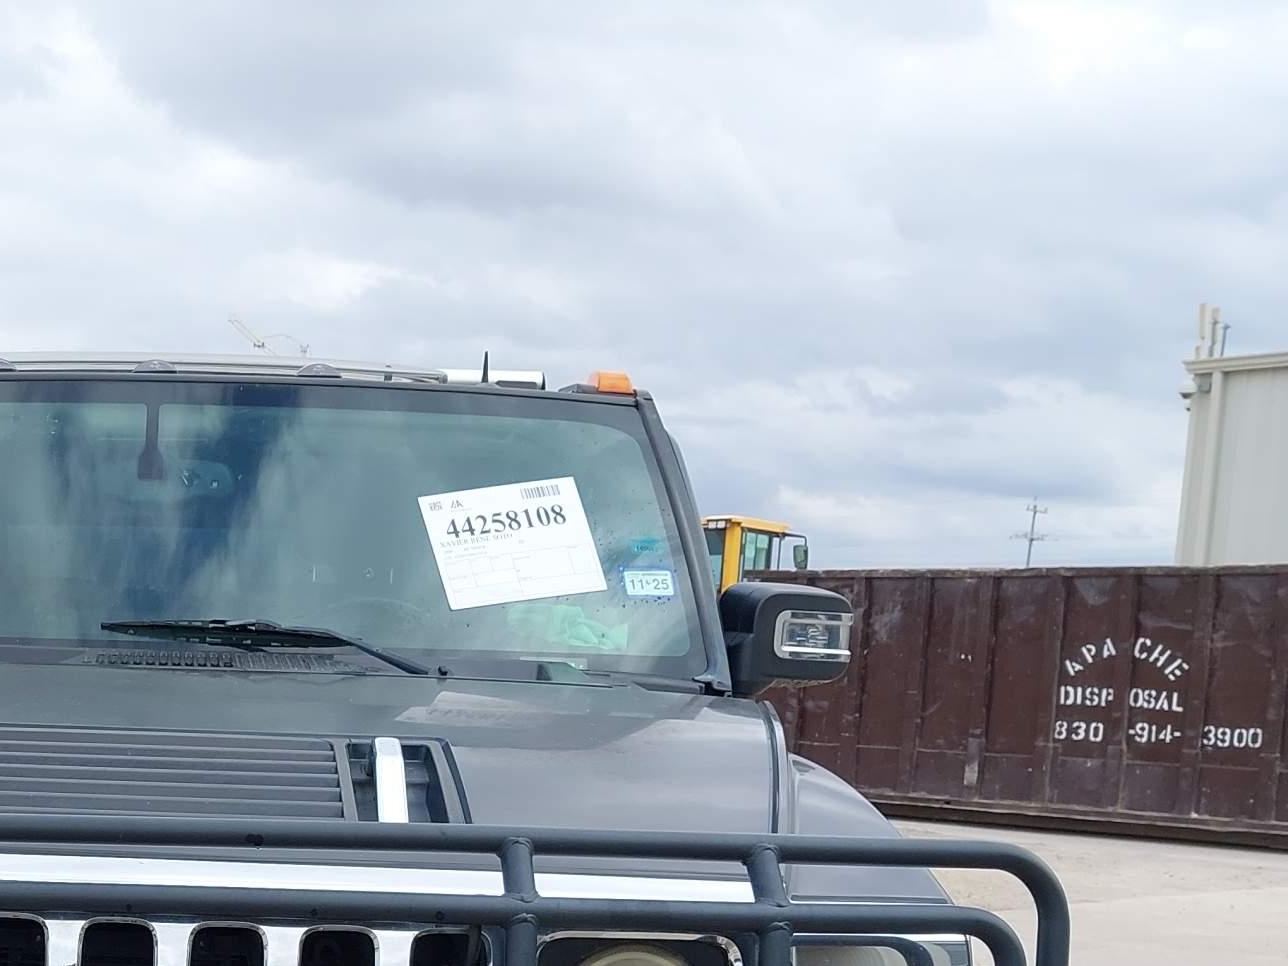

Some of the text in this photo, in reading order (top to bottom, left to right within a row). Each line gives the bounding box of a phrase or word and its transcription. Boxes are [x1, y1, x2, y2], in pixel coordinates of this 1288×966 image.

[446, 504, 567, 538] 44258108
[652, 577, 670, 591] 25
[1064, 637, 1191, 682] APACHE
[1059, 685, 1185, 713] DISPOSAL
